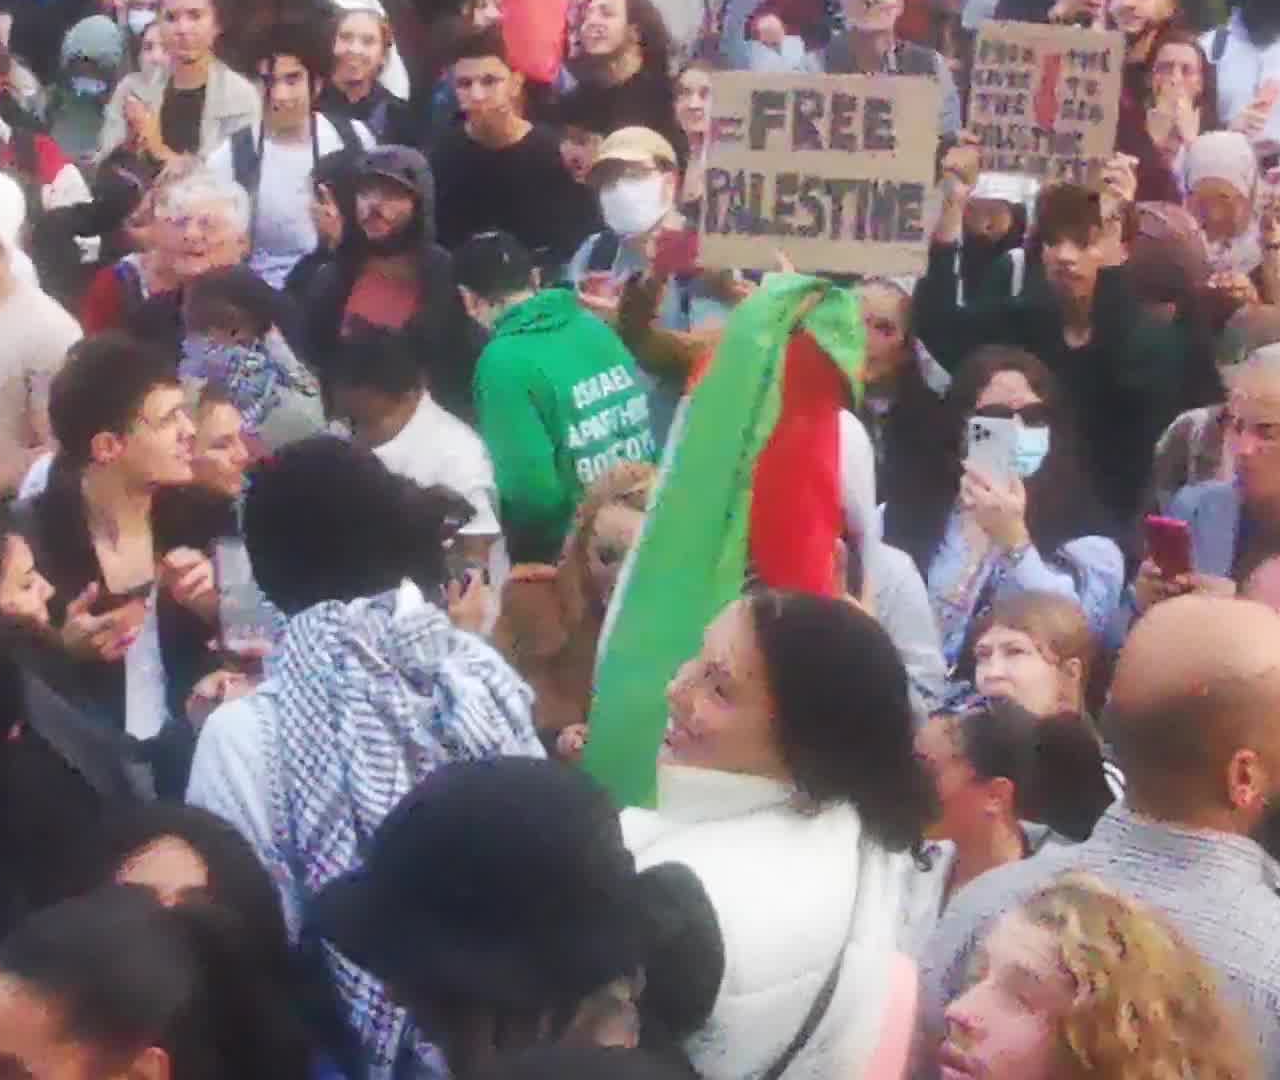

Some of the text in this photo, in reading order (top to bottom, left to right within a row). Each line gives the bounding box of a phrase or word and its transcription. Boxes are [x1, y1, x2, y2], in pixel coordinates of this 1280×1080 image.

[749, 89, 896, 151] FREE
[705, 168, 925, 242] PALESTINE
[576, 428, 657, 483] BOCO
